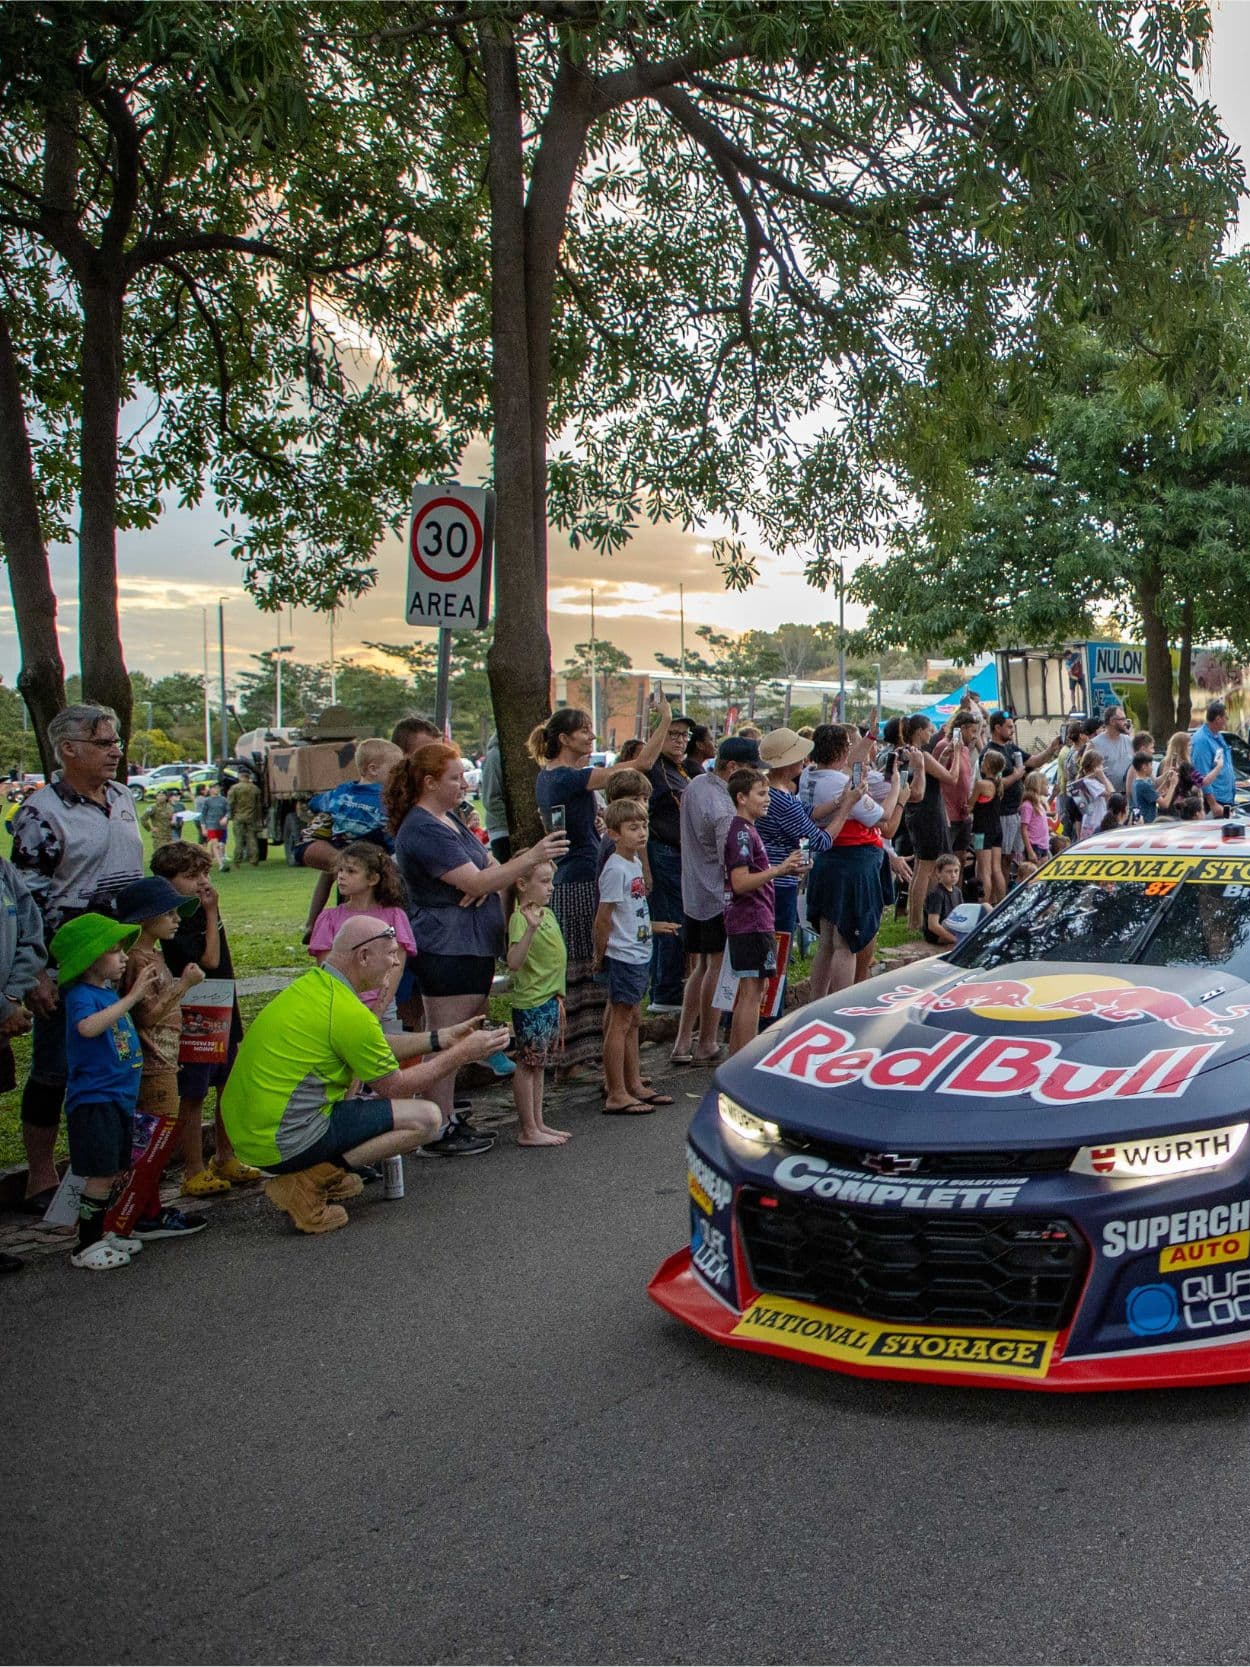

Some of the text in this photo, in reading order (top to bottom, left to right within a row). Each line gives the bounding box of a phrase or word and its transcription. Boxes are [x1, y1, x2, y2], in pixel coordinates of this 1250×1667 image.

[423, 520, 468, 558] 30
[409, 591, 476, 618] AREA
[1096, 649, 1142, 675] NULON
[1044, 859, 1188, 878] NATIONAL
[1144, 881, 1179, 897] 87
[755, 1021, 1226, 1103] Red Bull
[773, 1154, 1022, 1208] COMPLETE
[1169, 1239, 1241, 1264] AUTO
[745, 1306, 1036, 1364] NATIONAL STORAGE
